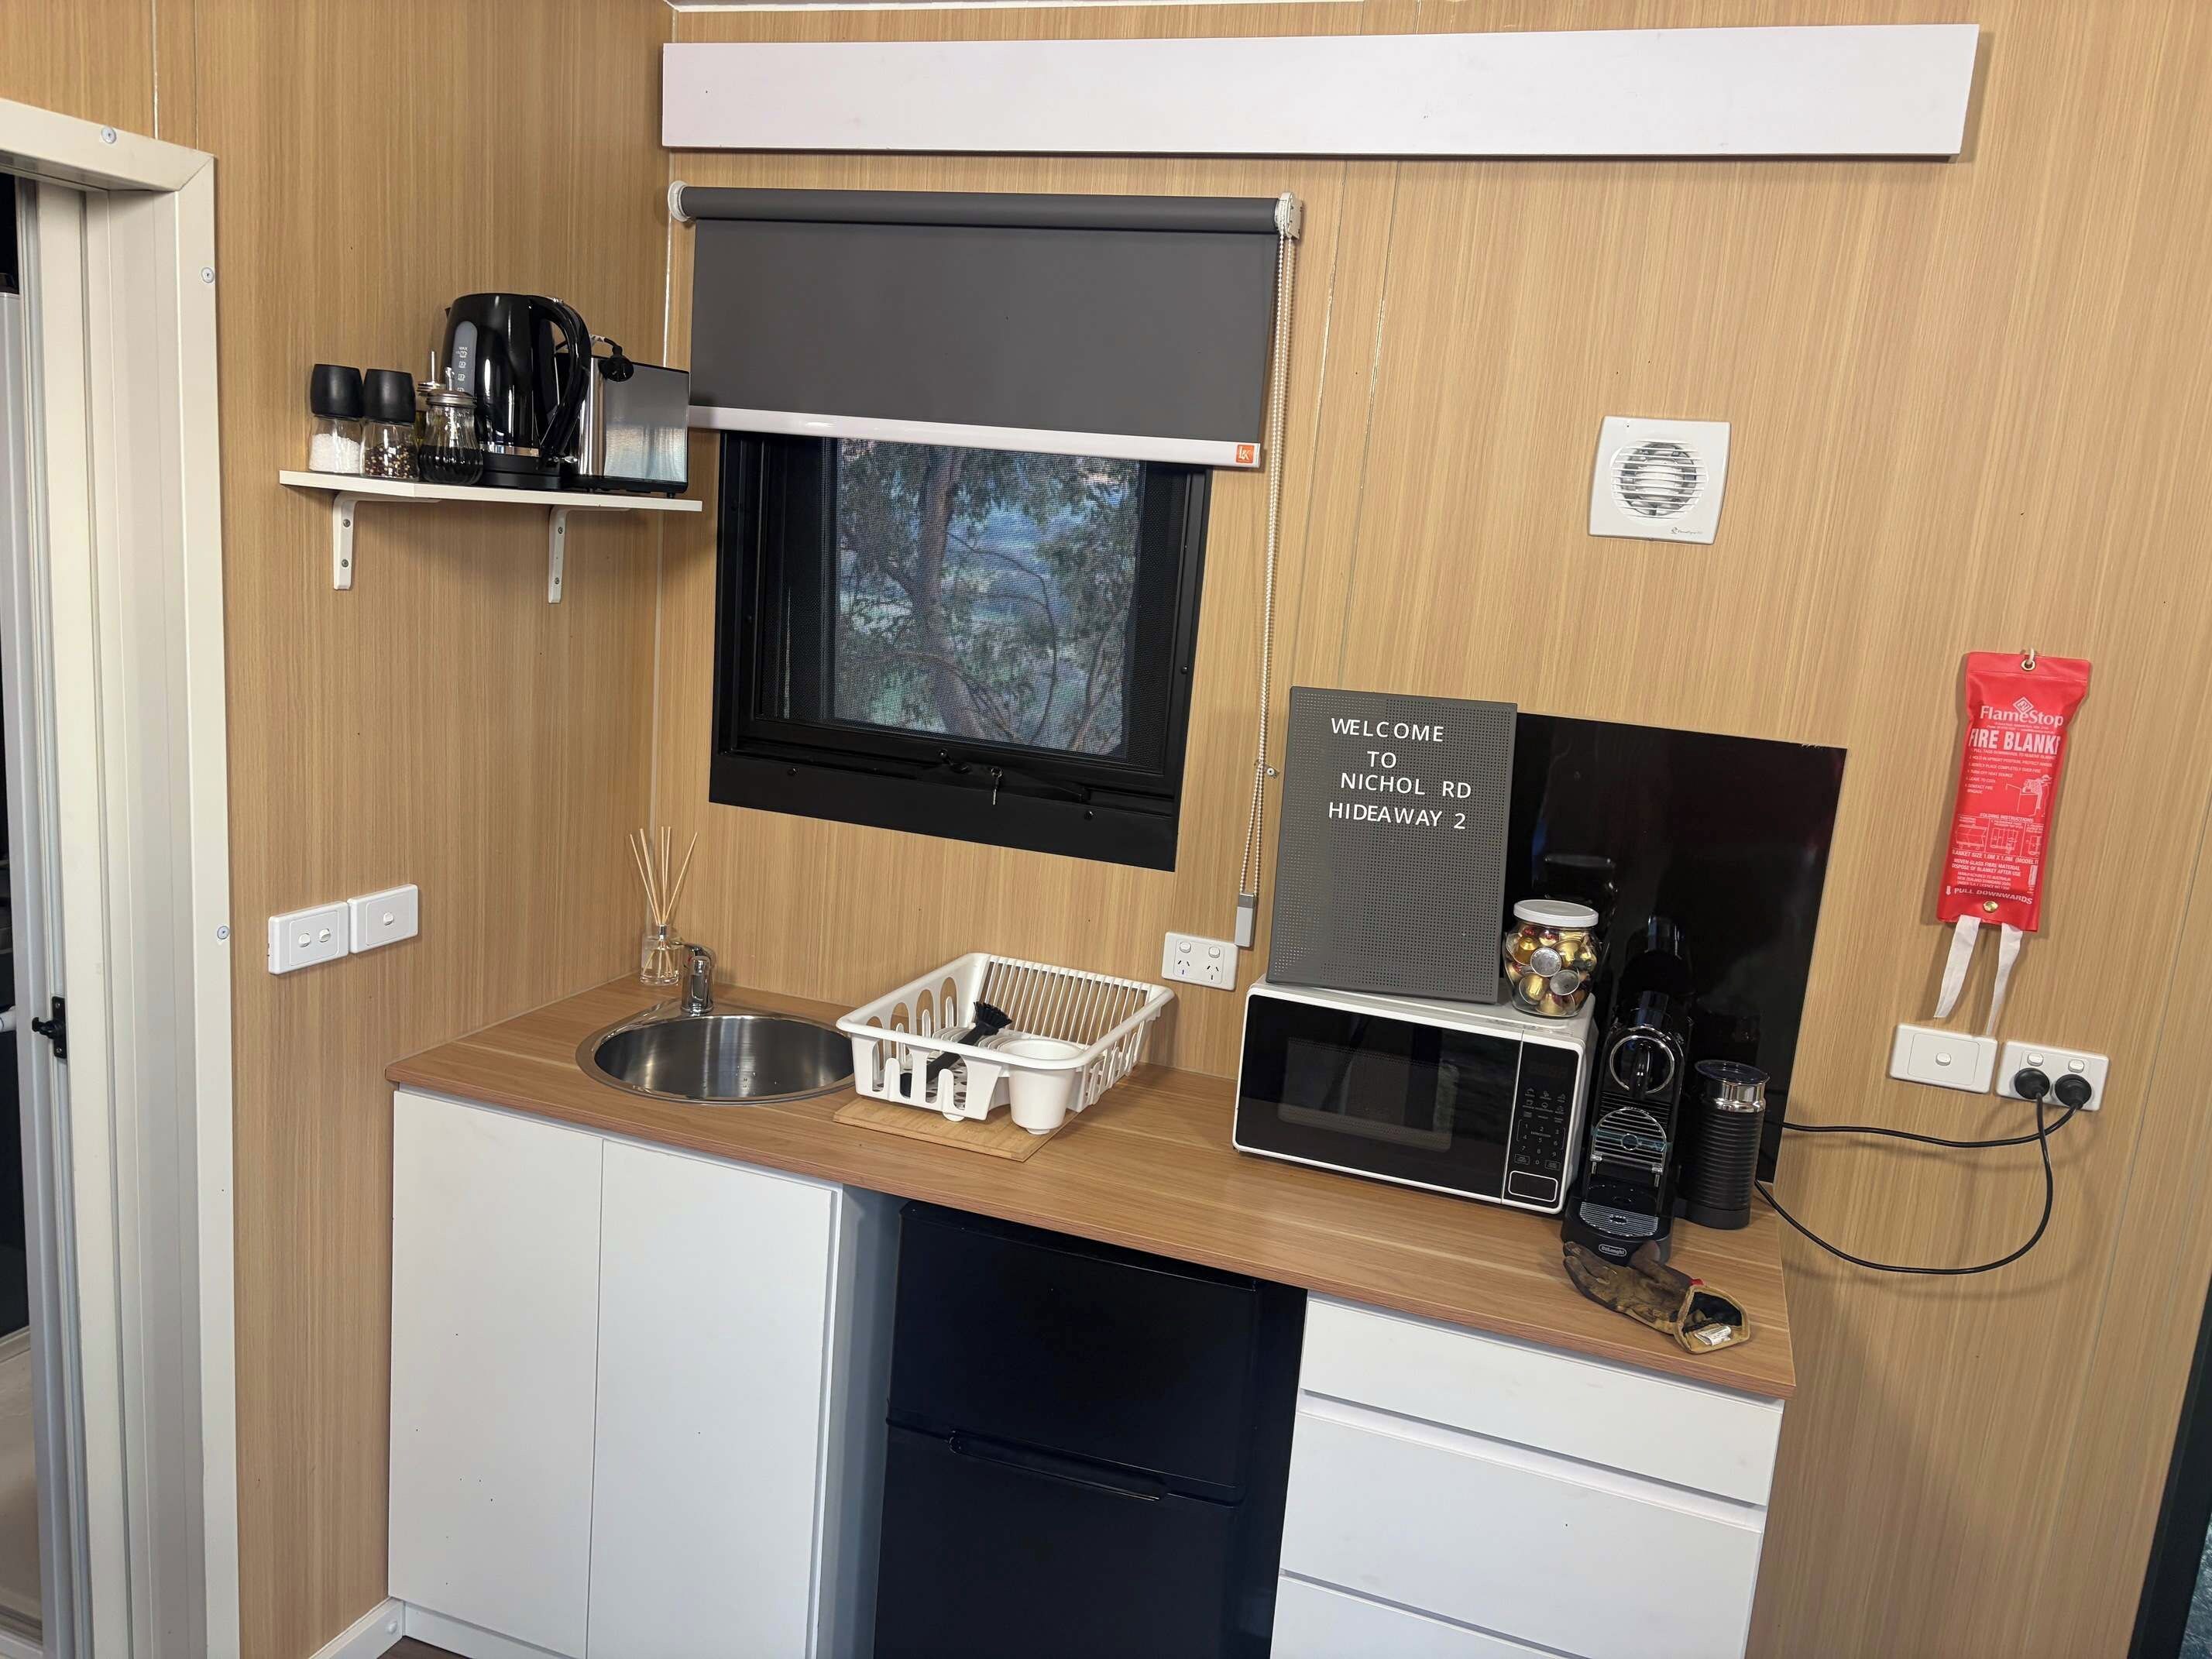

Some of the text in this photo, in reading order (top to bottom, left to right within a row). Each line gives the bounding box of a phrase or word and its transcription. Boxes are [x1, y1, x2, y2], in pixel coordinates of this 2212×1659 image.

[1980, 705, 2063, 728] FlameStop
[1331, 717, 1444, 742] WELCOME
[1969, 728, 1999, 749] FIRE
[1366, 751, 1397, 768] TO
[1341, 773, 1472, 799] NICHOL RD
[1329, 802, 1465, 829] HIDEAWAY 2
[1977, 890, 2033, 905] DOWNWARDS
